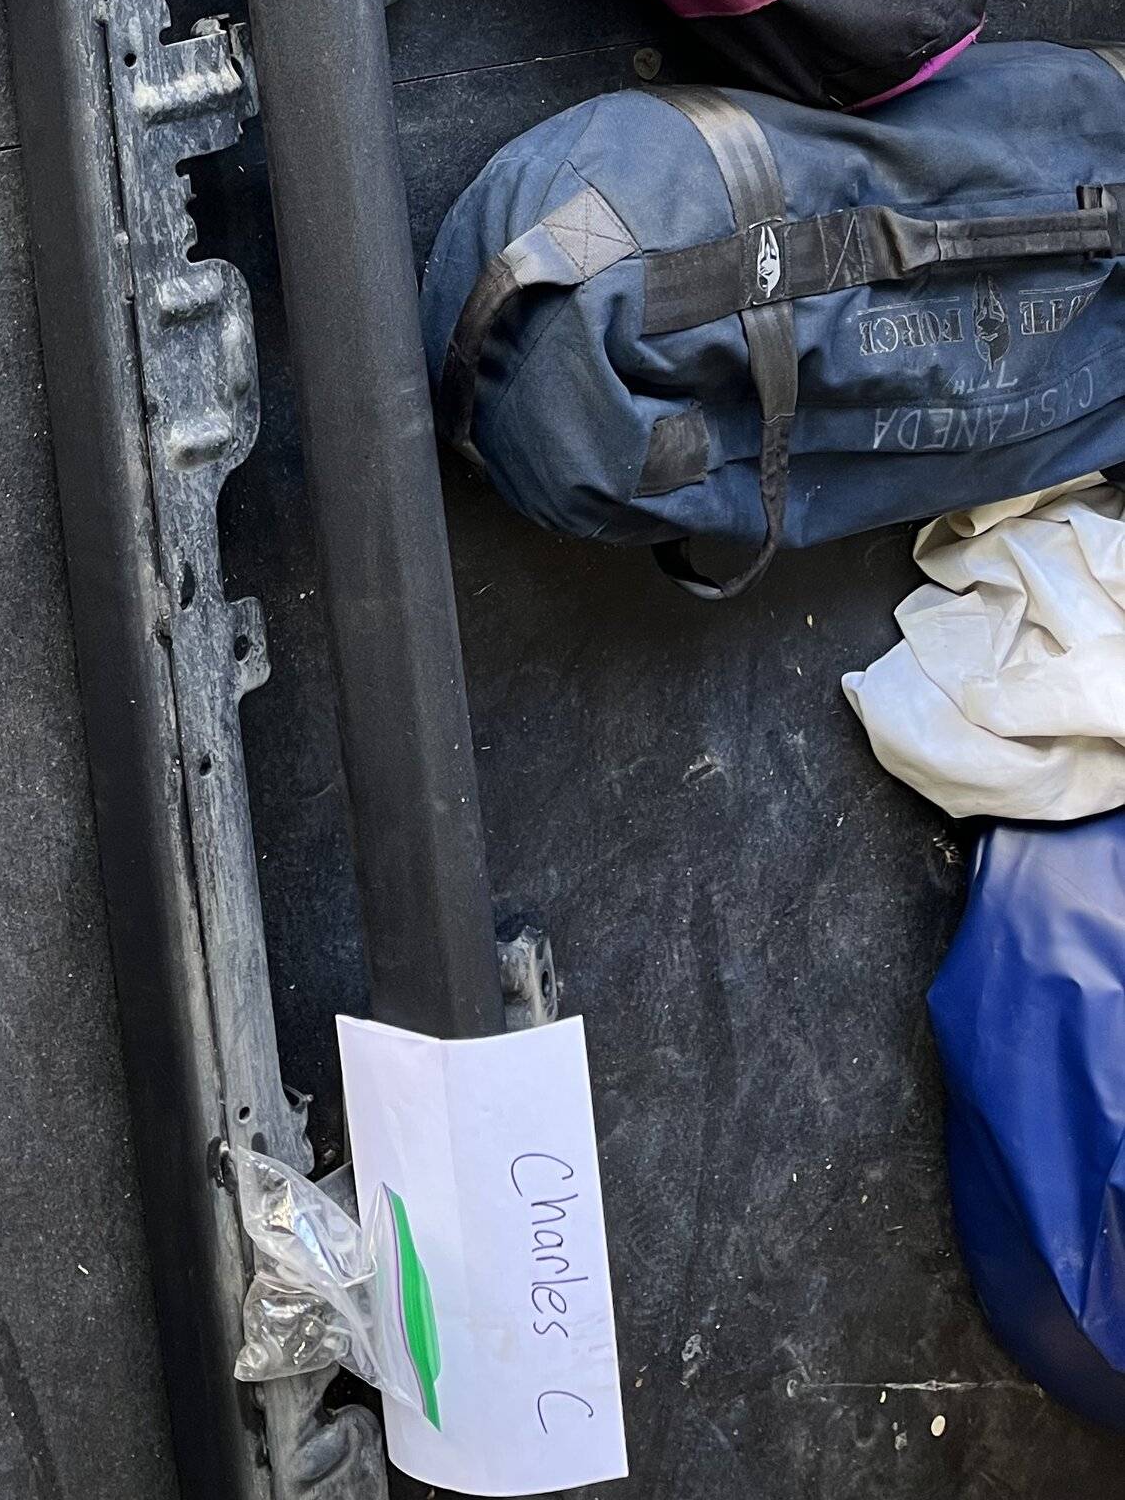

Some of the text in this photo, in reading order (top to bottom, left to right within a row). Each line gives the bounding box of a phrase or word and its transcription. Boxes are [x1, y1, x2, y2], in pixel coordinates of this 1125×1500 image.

[861, 309, 963, 356] FORCE
[510, 1153, 594, 1435] Charles C
